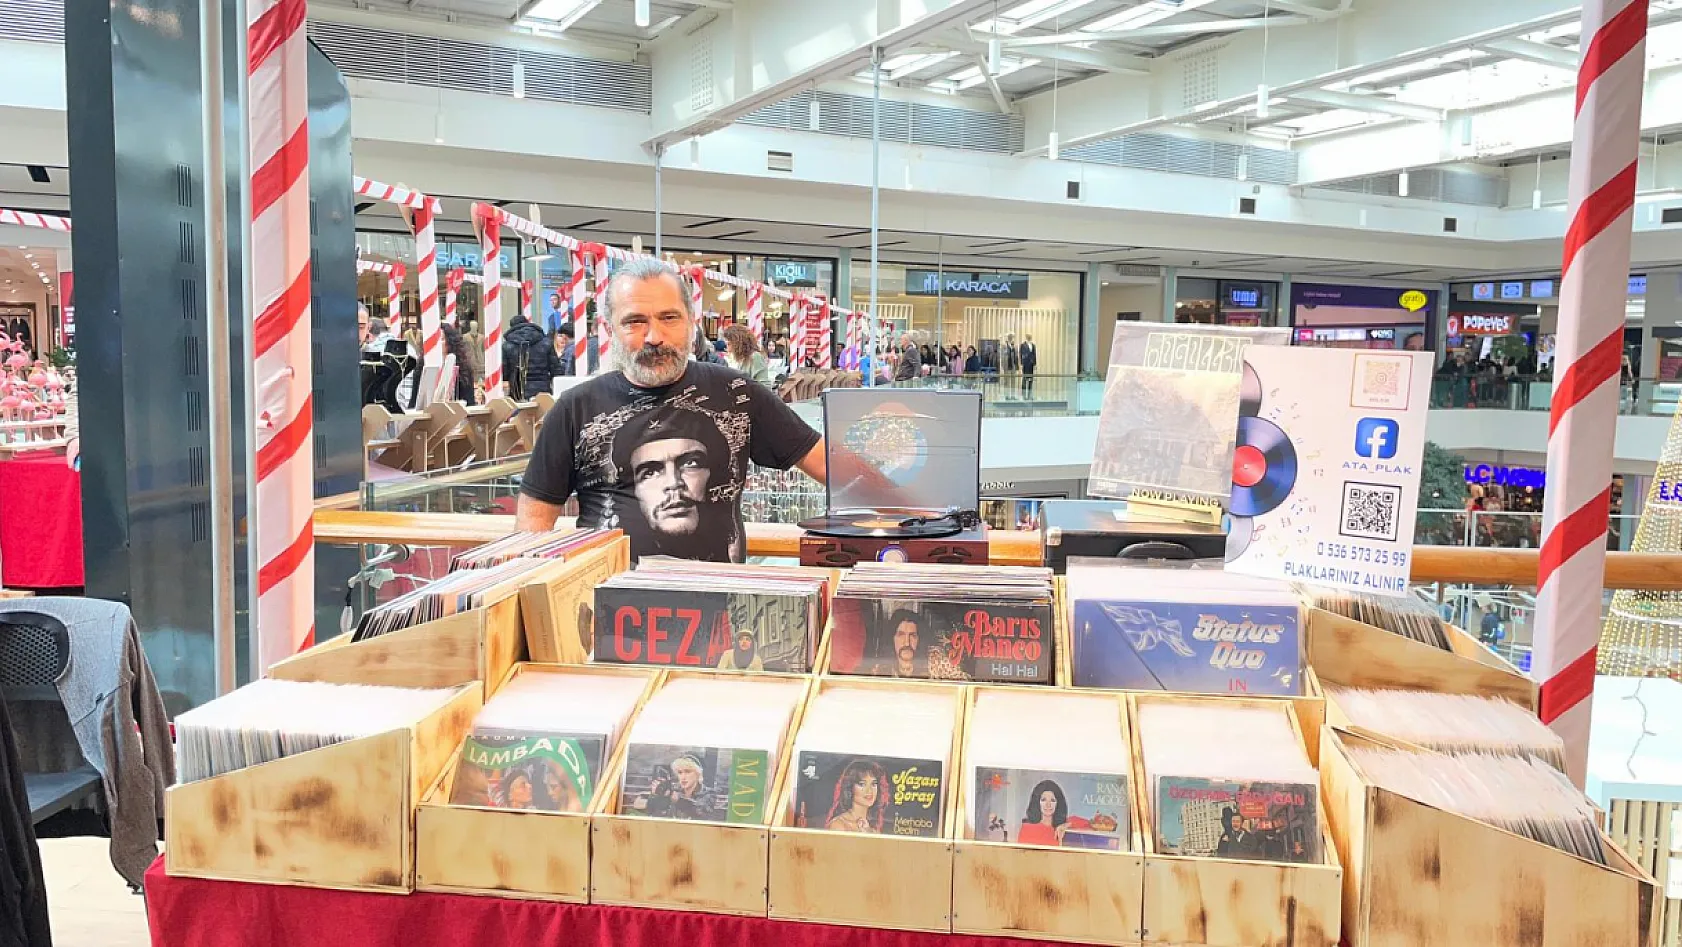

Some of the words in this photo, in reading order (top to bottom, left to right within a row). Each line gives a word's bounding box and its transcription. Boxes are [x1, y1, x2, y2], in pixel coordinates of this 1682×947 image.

[435, 251, 509, 268] SARR
[946, 280, 1011, 293] KARACA
[1342, 461, 1412, 475] ATA_PLAK
[1131, 488, 1163, 500] NOW
[1165, 491, 1220, 506] PLAYING
[1328, 543, 1347, 558] 536
[1351, 546, 1371, 562] 573
[1375, 549, 1389, 564] 25
[1392, 551, 1407, 566] 99
[1284, 561, 1360, 585] PLAKLARINIZ
[1363, 573, 1405, 592] ALINIR
[1192, 613, 1285, 644] Status
[1209, 641, 1266, 670] Quo
[991, 663, 1013, 676] Hal
[1016, 665, 1038, 678] Hal
[1228, 678, 1248, 692] IN
[731, 756, 761, 818] MAD
[891, 766, 940, 790] Nazan
[1096, 782, 1127, 793] RANA
